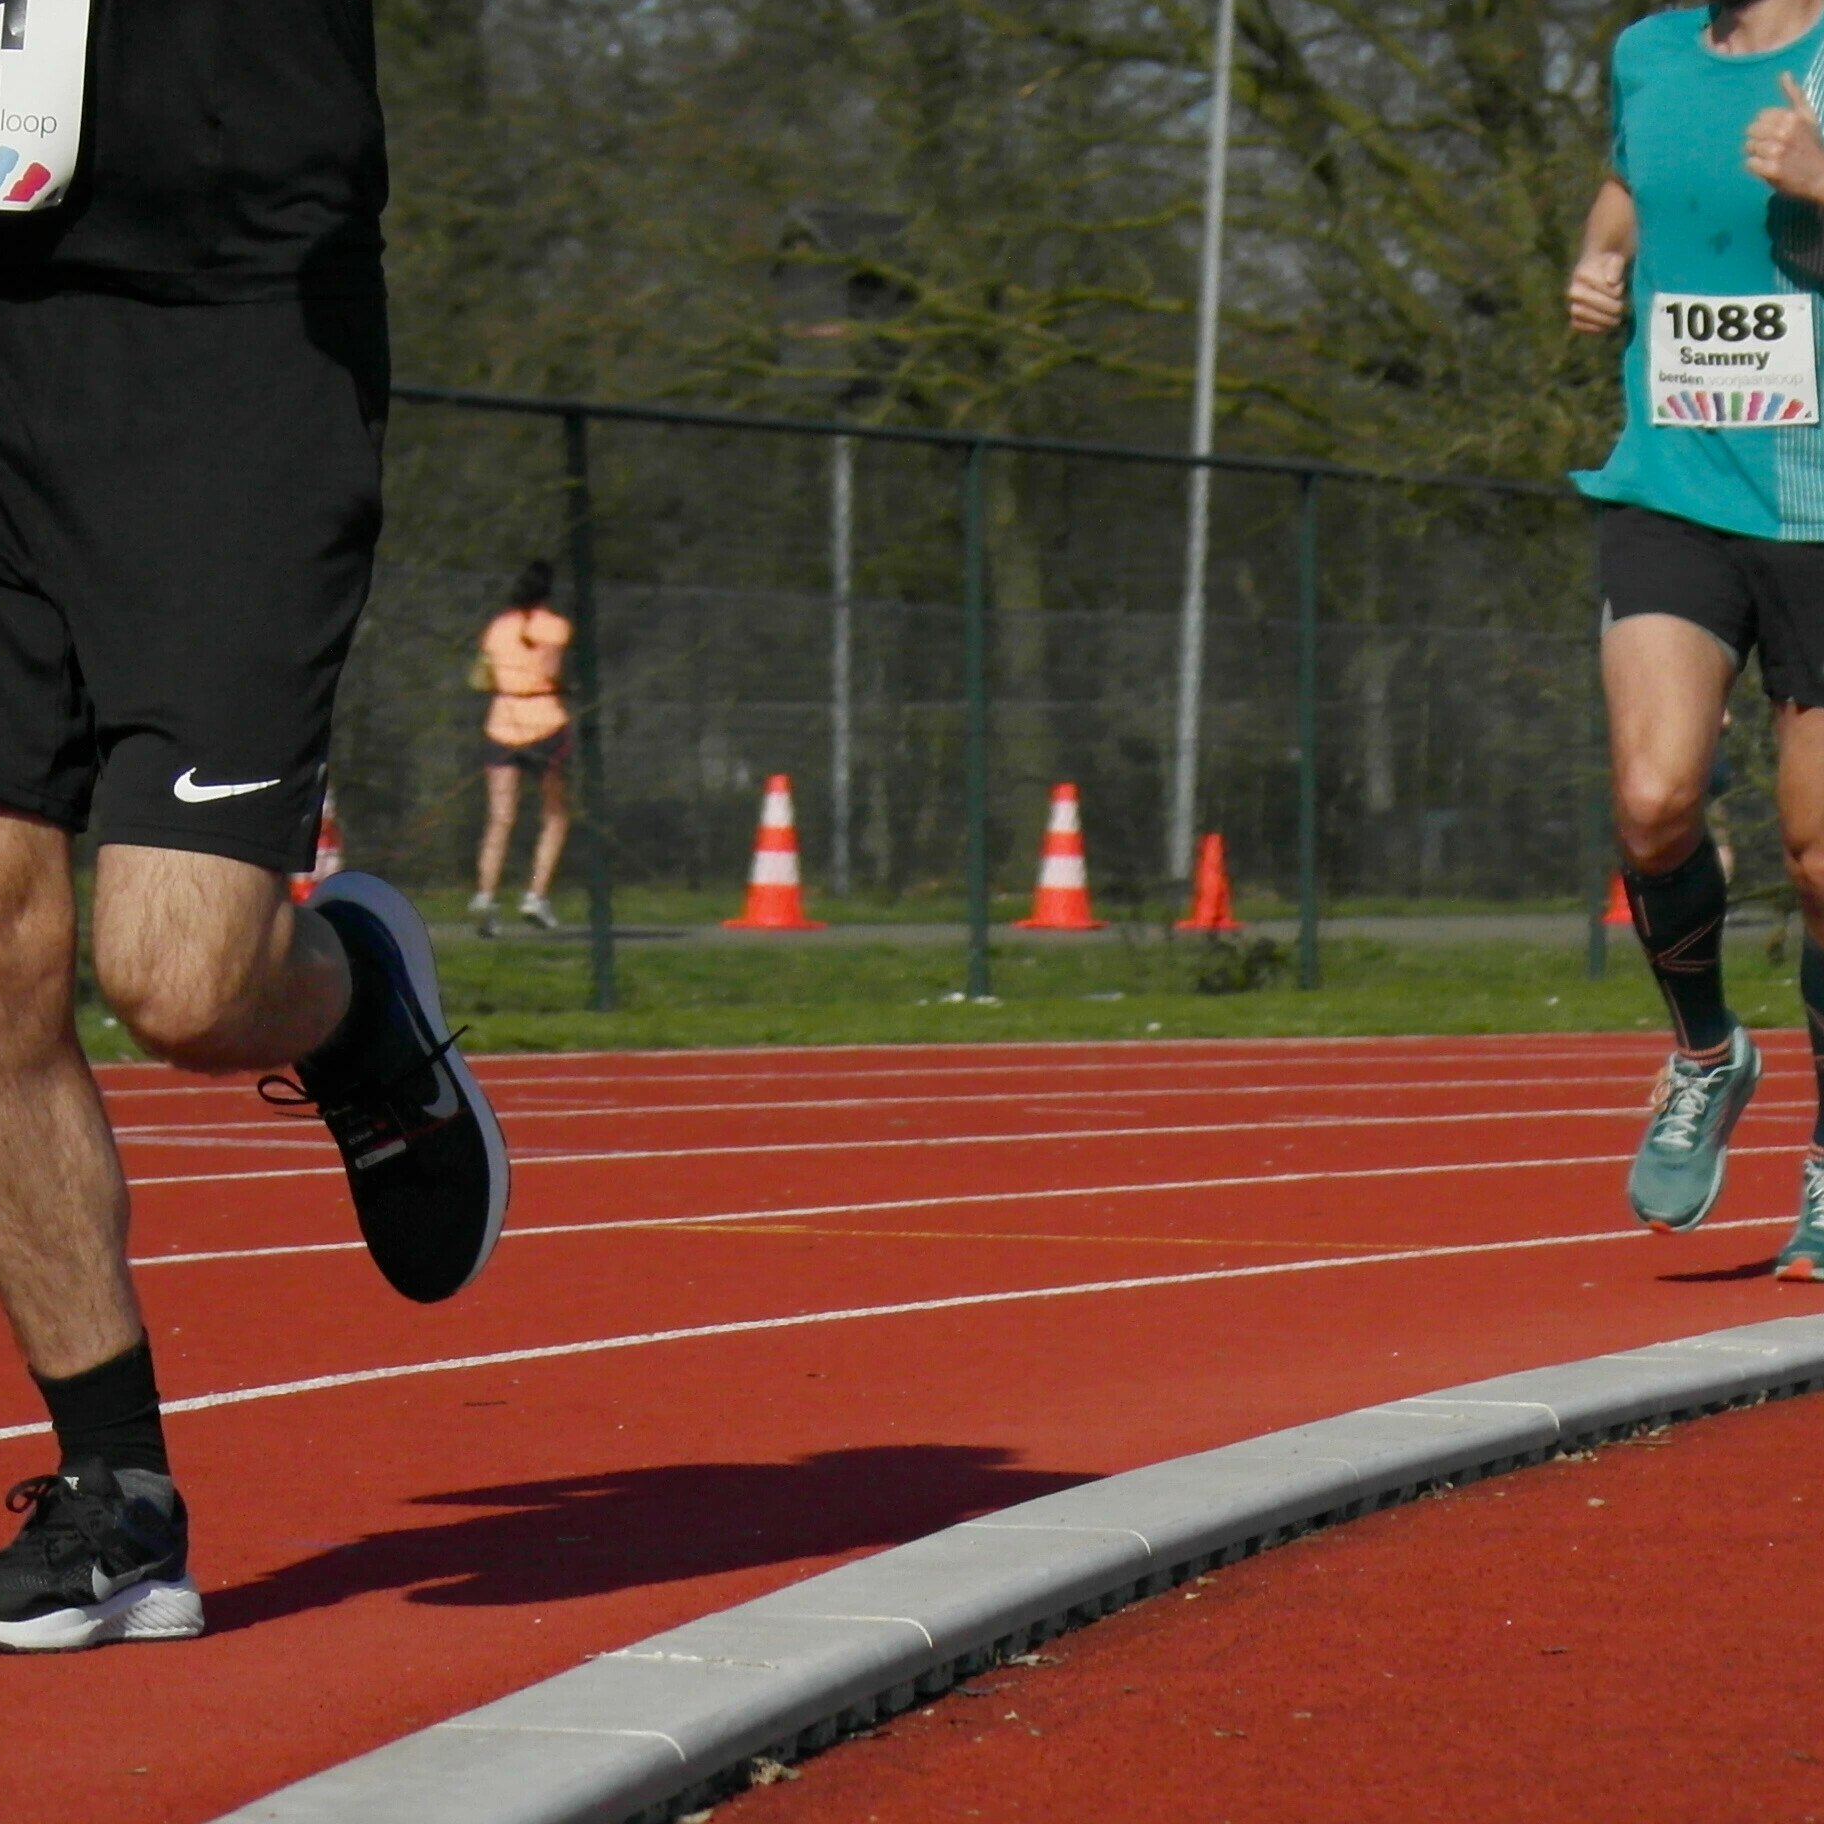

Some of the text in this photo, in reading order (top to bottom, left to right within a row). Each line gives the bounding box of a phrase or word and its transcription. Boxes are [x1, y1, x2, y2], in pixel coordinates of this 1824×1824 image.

[1666, 301, 1788, 342] 1088
[1680, 346, 1771, 371] Sammy
[1658, 370, 1704, 386] berden
